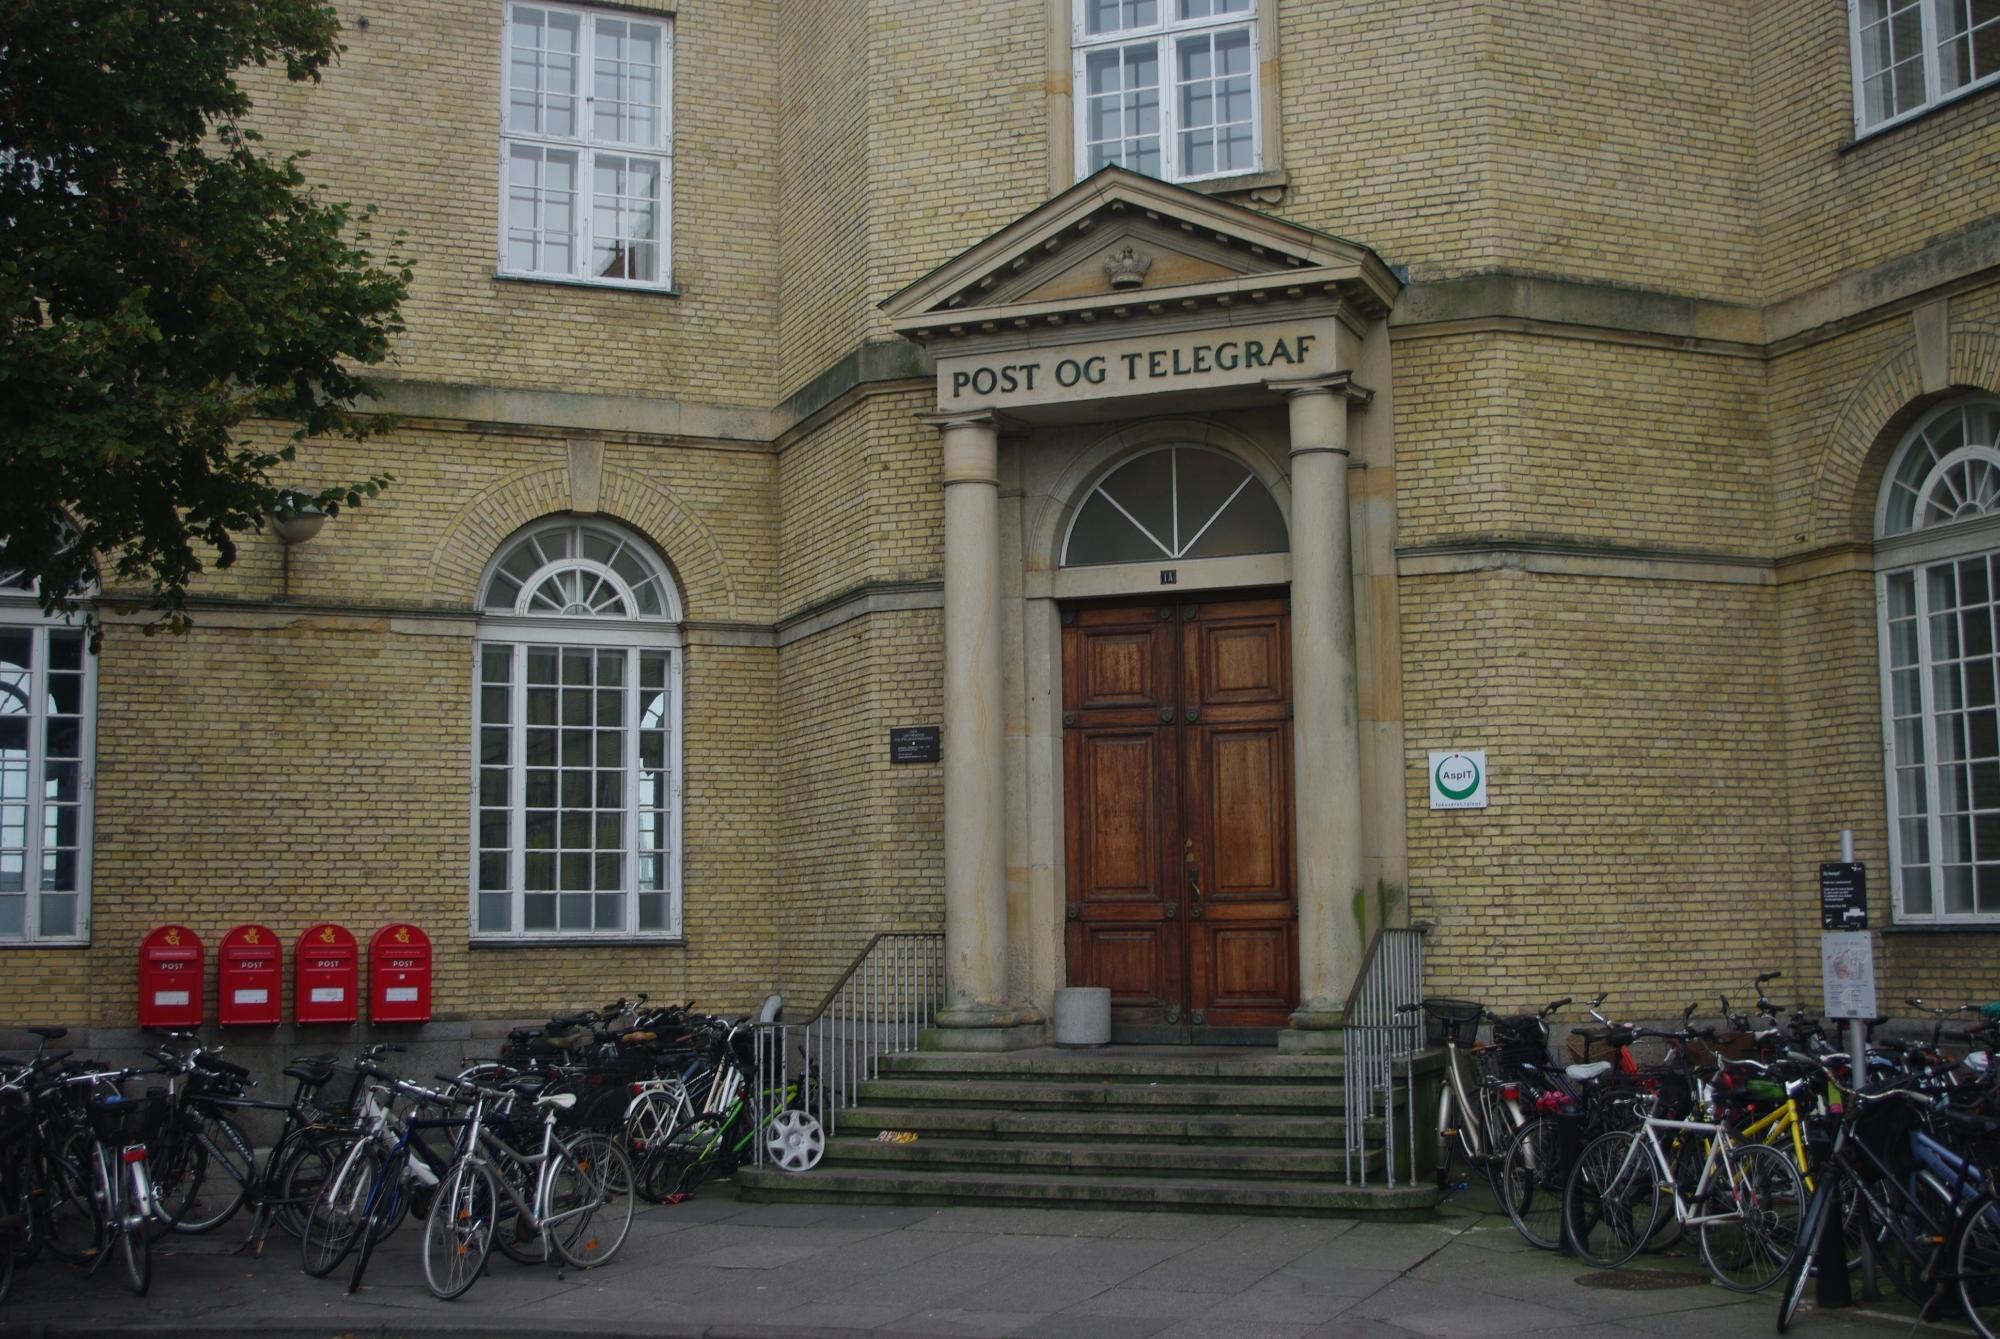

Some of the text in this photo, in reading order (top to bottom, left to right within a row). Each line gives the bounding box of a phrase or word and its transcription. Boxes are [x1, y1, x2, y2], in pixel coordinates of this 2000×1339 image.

[952, 335, 1317, 399] POST OG TELEGRAF
[1443, 770, 1473, 780] AspIT
[160, 961, 185, 971] POST
[240, 960, 264, 970] POST
[317, 959, 341, 969] POST
[392, 959, 415, 969] POST
